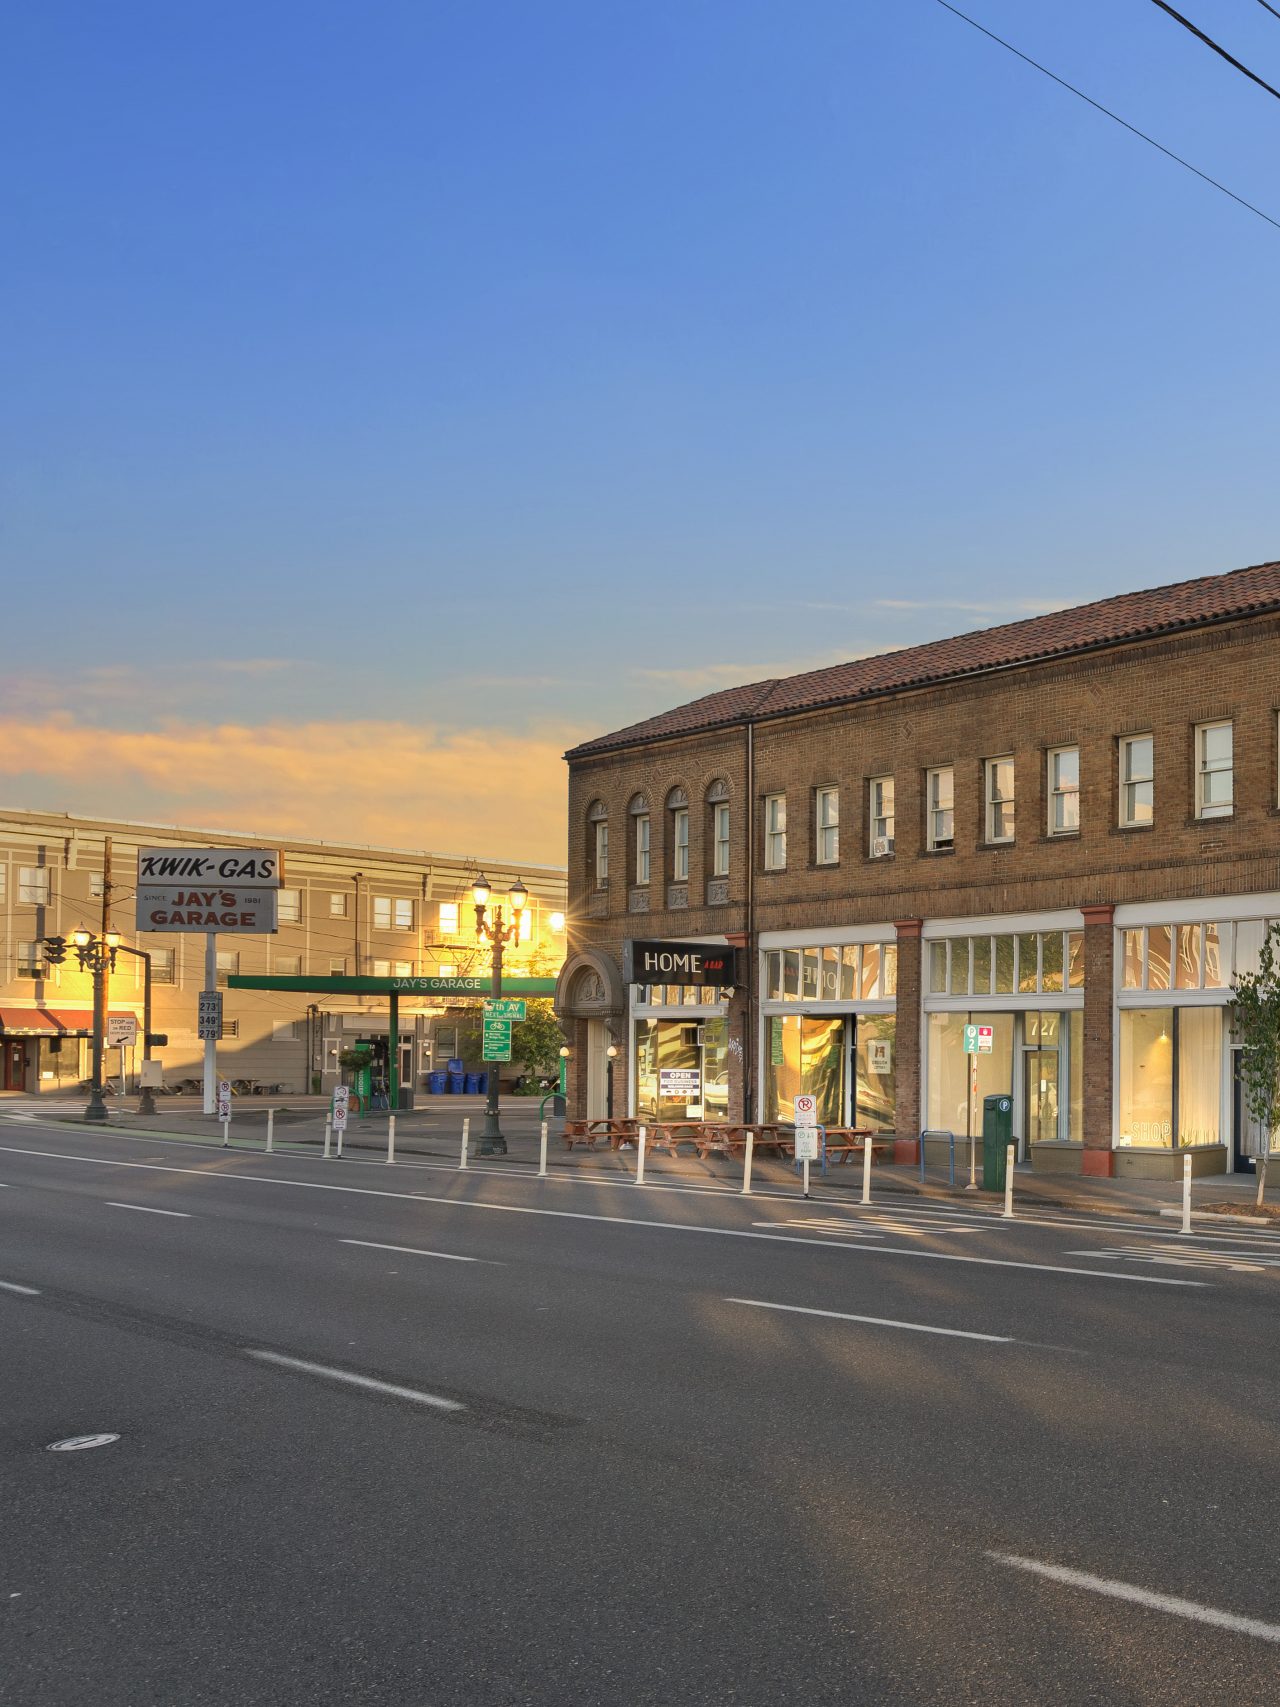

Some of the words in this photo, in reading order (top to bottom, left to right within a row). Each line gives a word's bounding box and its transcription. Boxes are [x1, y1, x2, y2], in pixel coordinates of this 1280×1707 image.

[141, 856, 276, 879] KWIK-GAS
[171, 889, 238, 908] JAY'S
[150, 909, 256, 927] GARAGE
[644, 951, 702, 973] HOME
[393, 978, 428, 989] JAY'S
[430, 978, 481, 989] GARAGE
[509, 1003, 520, 1011] AV
[1030, 1019, 1056, 1036] 727
[968, 1038, 975, 1049] 2
[1131, 1121, 1171, 1142] SHOP
